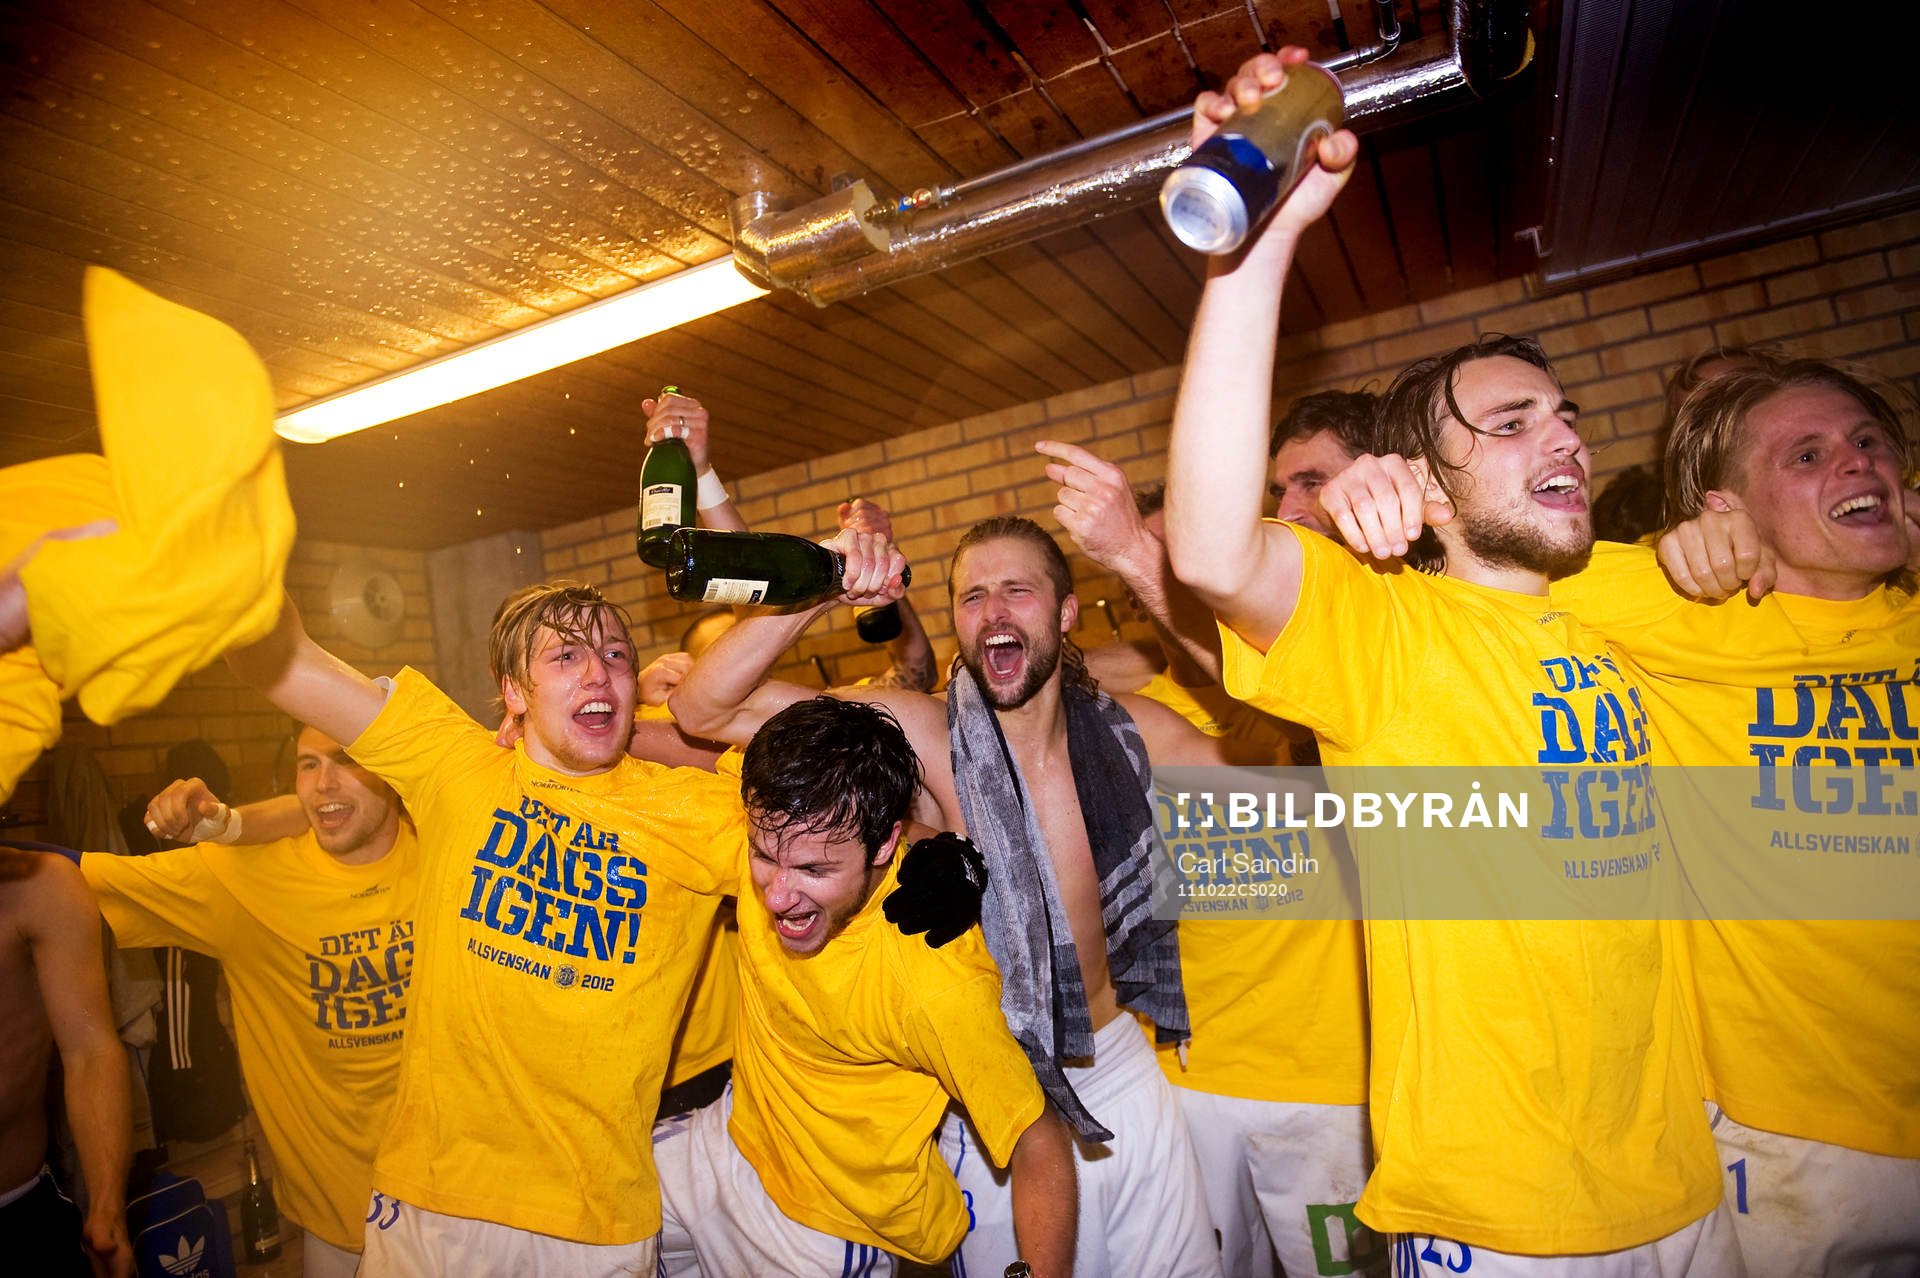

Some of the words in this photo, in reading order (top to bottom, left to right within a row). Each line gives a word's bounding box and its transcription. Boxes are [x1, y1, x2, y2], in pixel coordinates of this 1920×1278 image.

[1750, 744, 1920, 816] IGE
[475, 807, 648, 909] DAGS
[1168, 829, 1312, 888] GEN!
[1564, 853, 1649, 879] ALLSVENSKAN
[1770, 830, 1910, 855] ALLSVENSKAN
[460, 865, 642, 964] IGEN!
[1277, 889, 1304, 906] 2012
[305, 941, 414, 995] DAG
[319, 927, 381, 956] DET
[467, 937, 552, 980] ALLSVENSKAN
[581, 974, 615, 991] 2012
[311, 979, 411, 1030] IGE
[1727, 1158, 1749, 1214] 1
